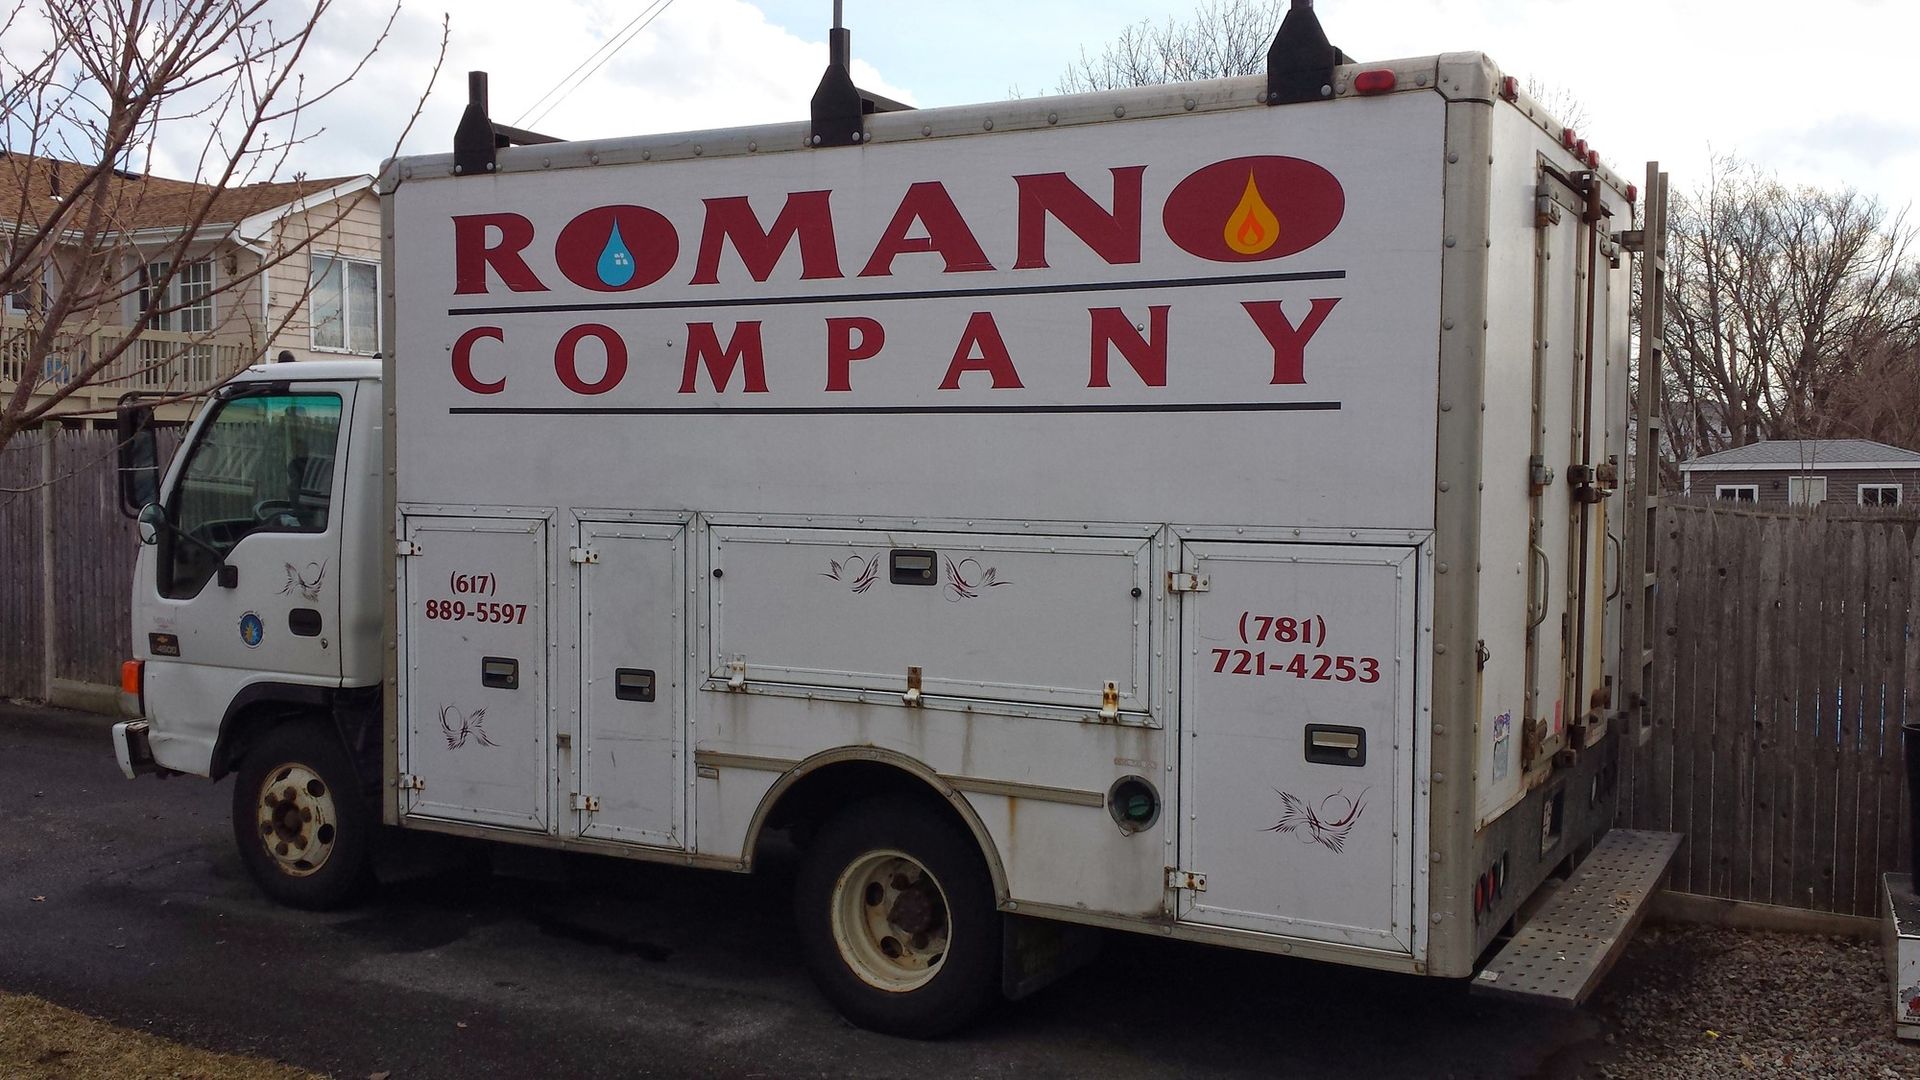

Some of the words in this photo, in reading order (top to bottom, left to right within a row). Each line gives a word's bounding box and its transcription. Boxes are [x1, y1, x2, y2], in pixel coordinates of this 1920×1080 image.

[450, 155, 1345, 295] ROMANO
[450, 297, 1342, 395] COMPANY
[450, 570, 496, 597] (617)
[425, 599, 527, 625] 889-5597
[1238, 611, 1326, 648] (781)
[1211, 648, 1380, 684] 721-4253
